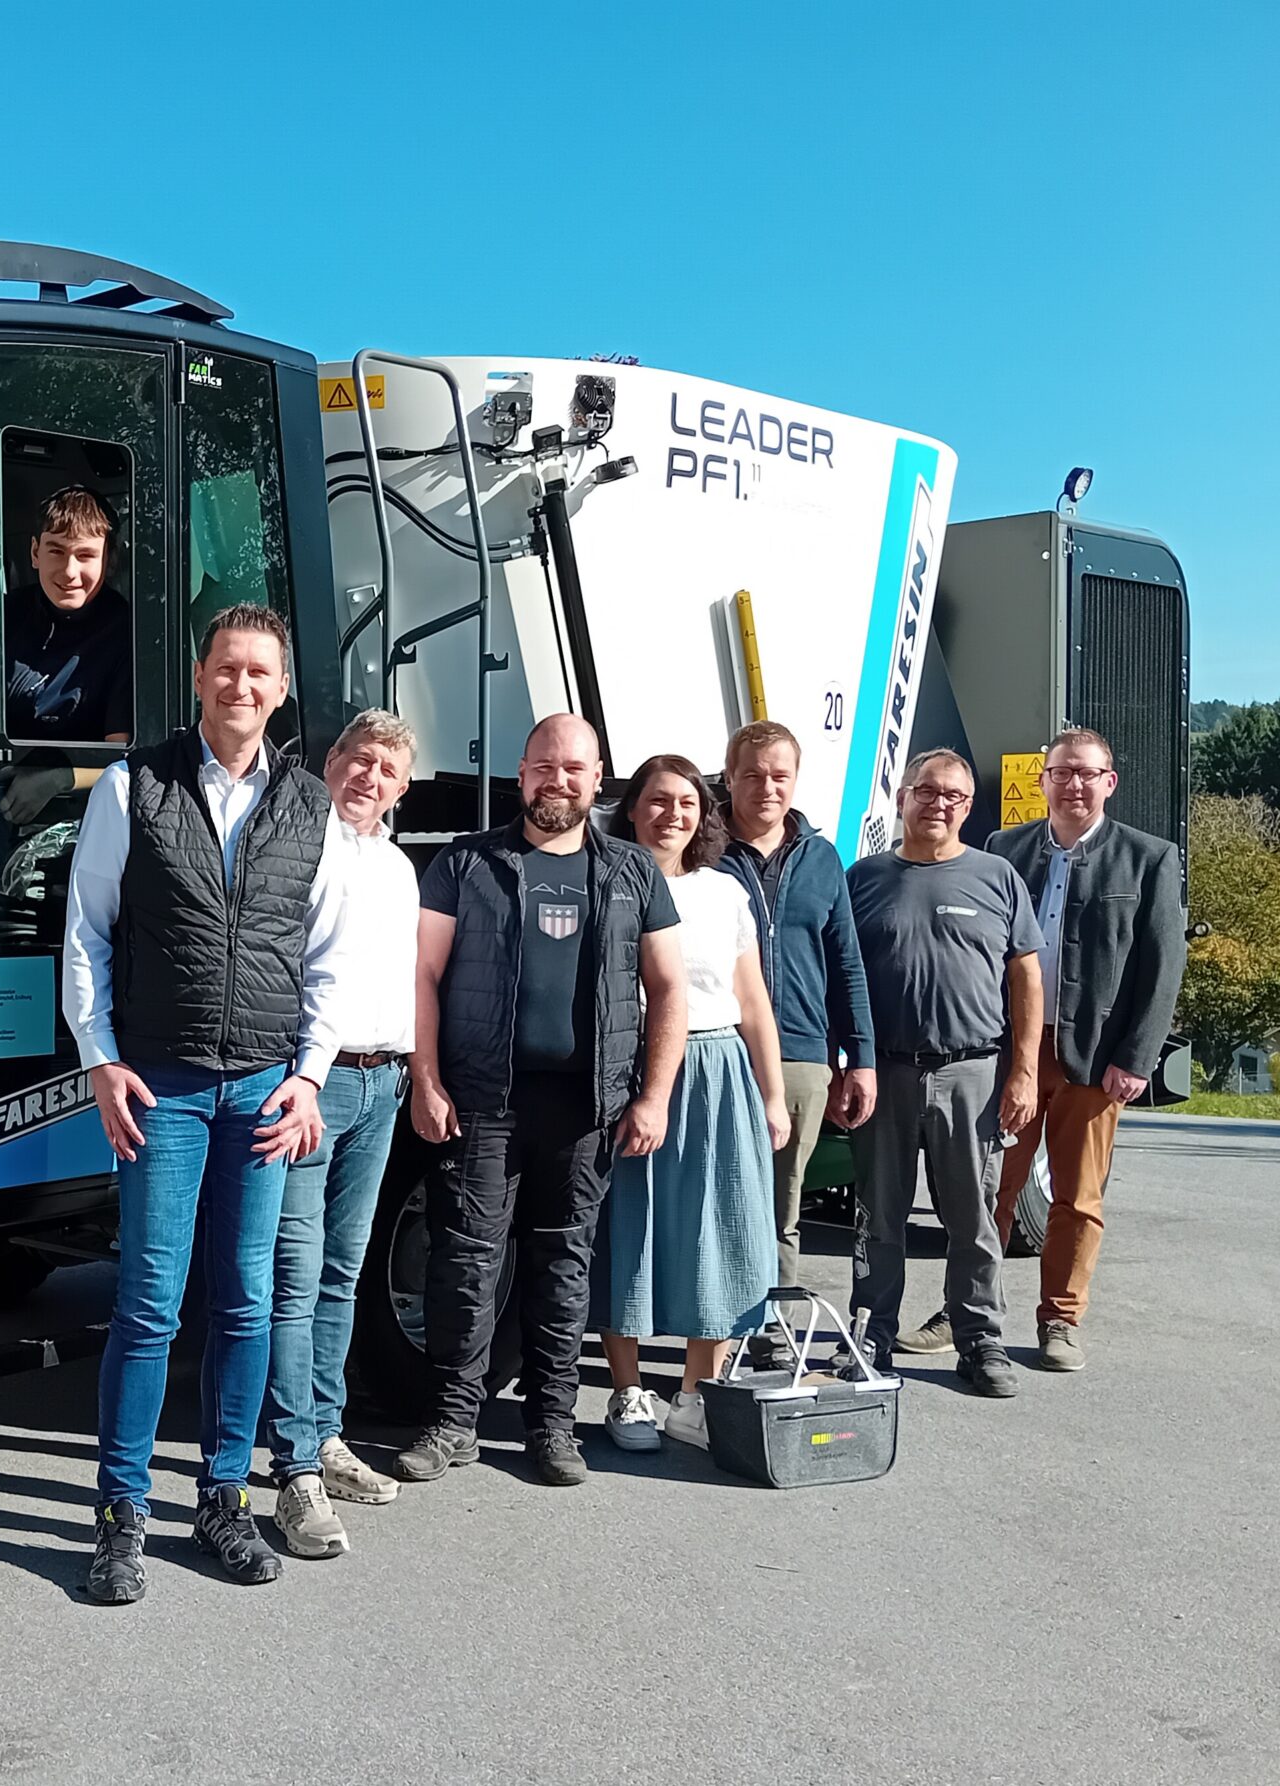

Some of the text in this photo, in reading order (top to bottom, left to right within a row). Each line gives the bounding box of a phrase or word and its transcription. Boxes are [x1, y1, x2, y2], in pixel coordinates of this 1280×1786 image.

[189, 363, 208, 375] FAR
[671, 392, 833, 469] LEADER
[881, 539, 926, 799] FARESIN
[824, 692, 843, 731] 20
